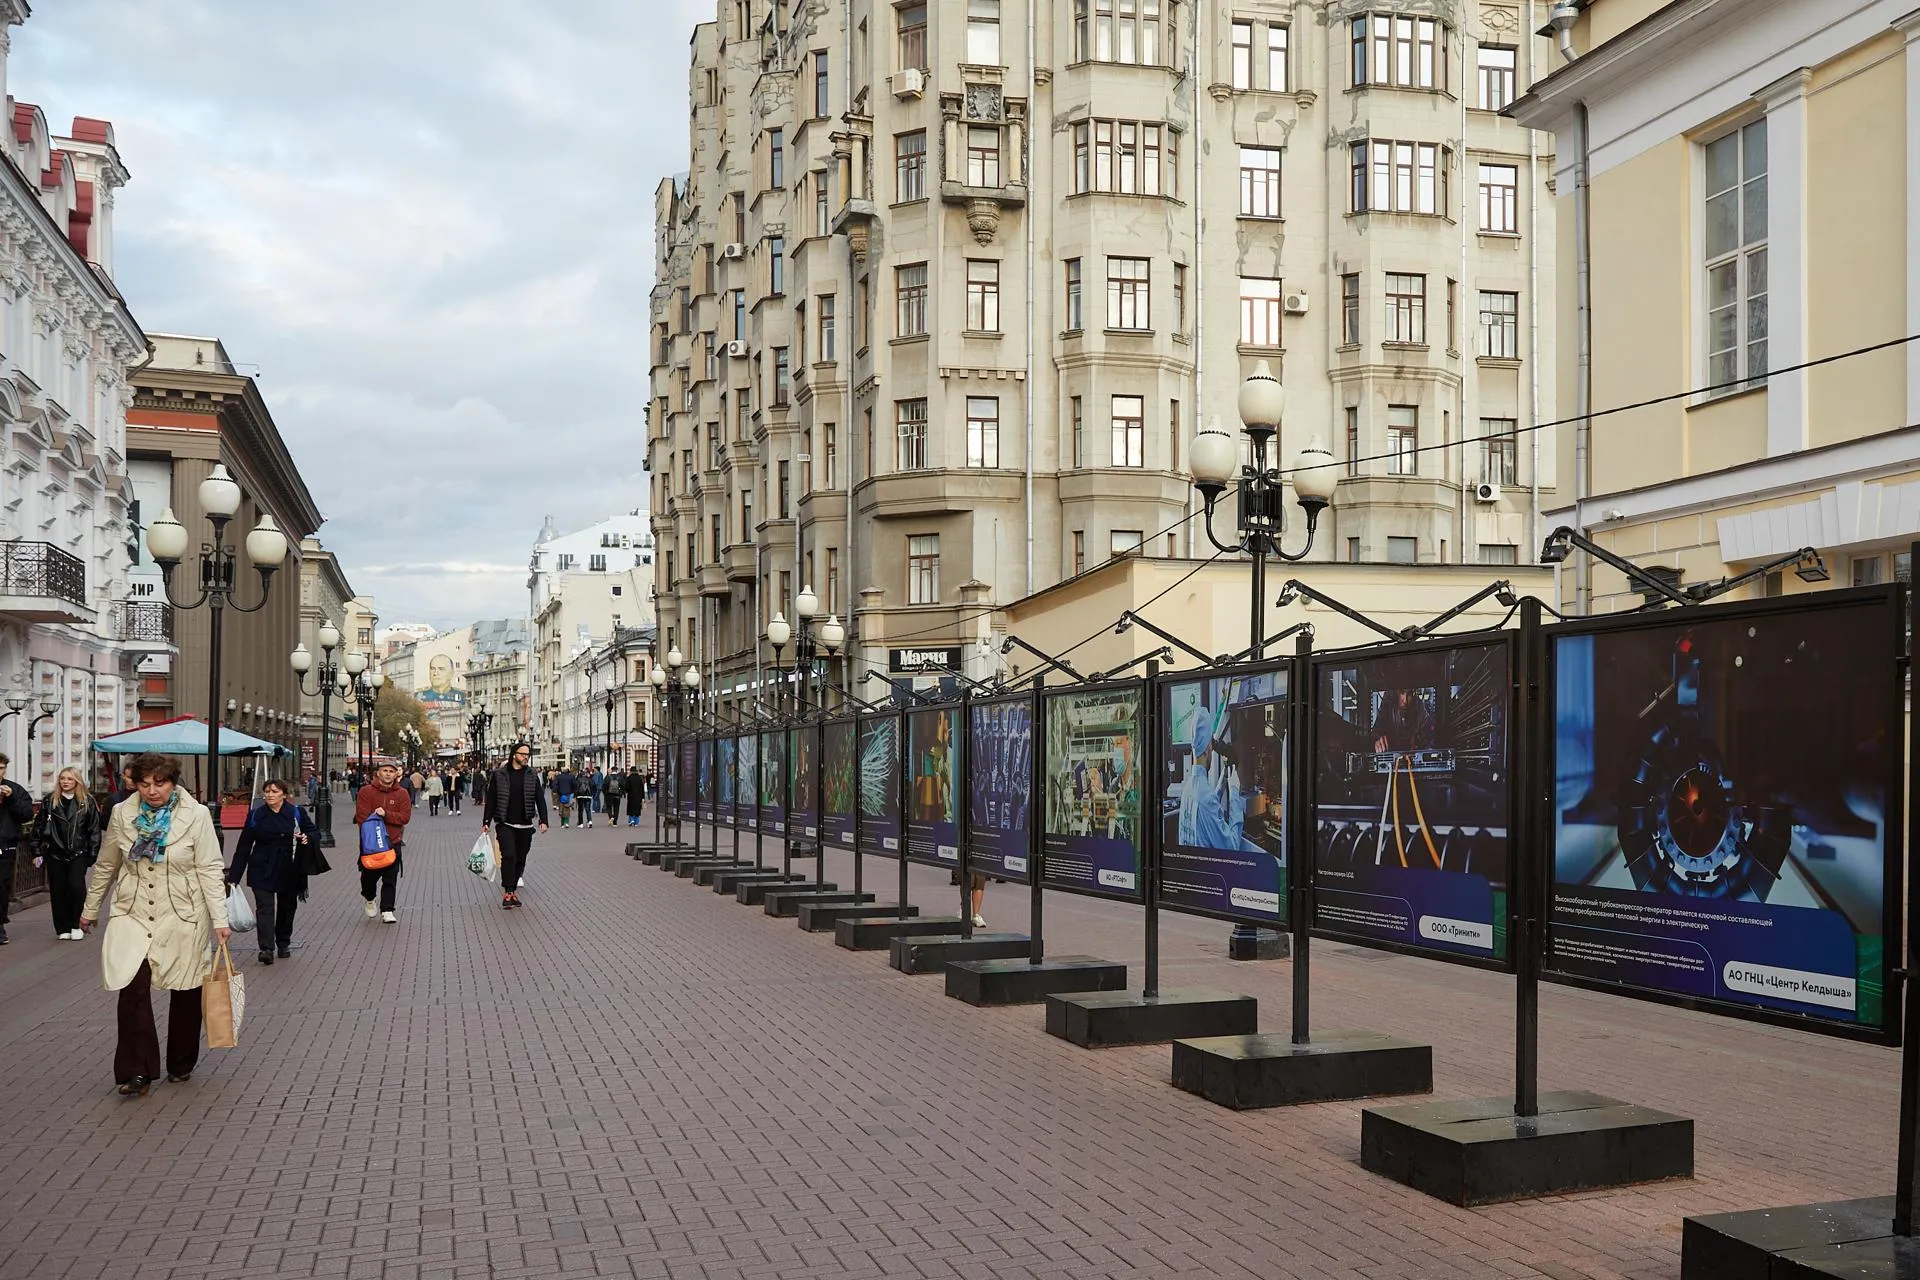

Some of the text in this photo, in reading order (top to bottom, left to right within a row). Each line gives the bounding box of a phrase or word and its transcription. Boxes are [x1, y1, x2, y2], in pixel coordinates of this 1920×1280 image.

[900, 649, 948, 666] Мария
[1554, 894, 1773, 928] Высокооборотный турбокомпрессор-генератор является ключевой составляющей
[1554, 905, 1574, 913] системы
[1574, 907, 1615, 919] преобразования
[1615, 912, 1639, 922] тепловой
[1639, 916, 1661, 926] энергии
[1666, 919, 1710, 931] электрическую.
[1431, 922, 1481, 938] ООО «Тринити»
[1728, 969, 1852, 998] АО ГНЦ «Центр Келдыша»
